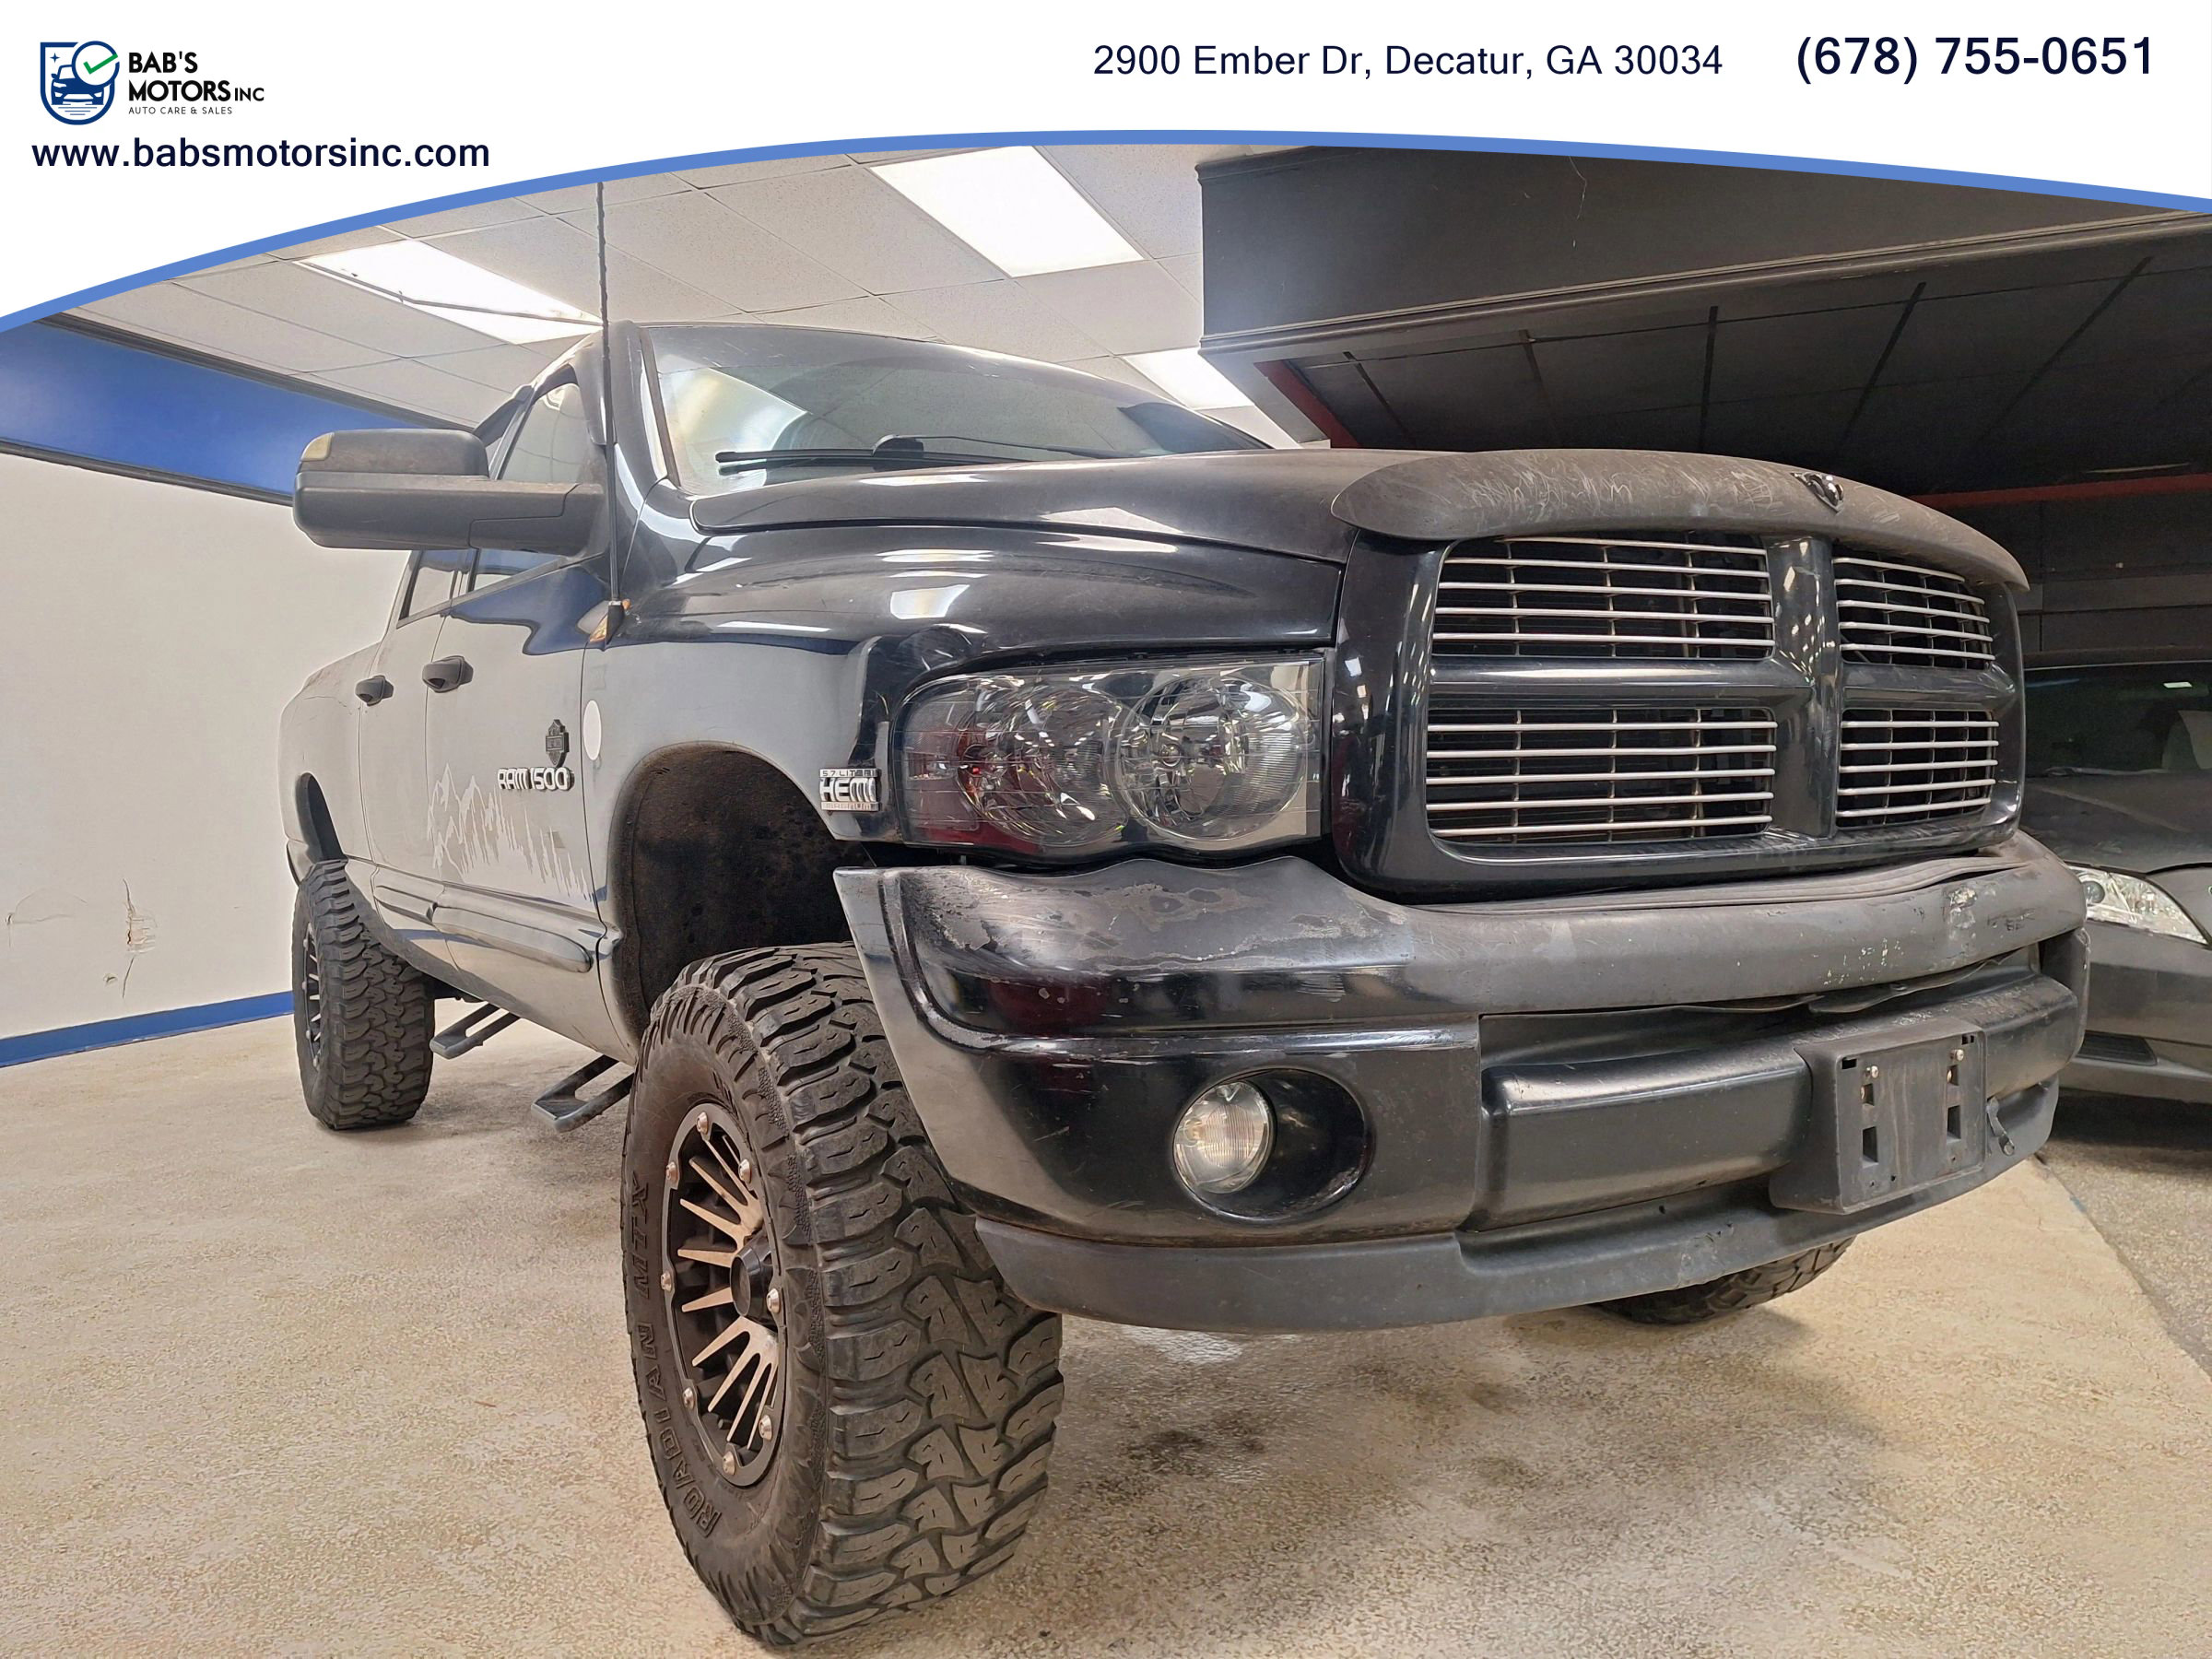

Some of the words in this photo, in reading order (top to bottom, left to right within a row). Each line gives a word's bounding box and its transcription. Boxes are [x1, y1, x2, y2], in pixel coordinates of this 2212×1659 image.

[498, 768, 529, 790] RAM
[529, 767, 571, 792] 1500
[819, 777, 877, 803] HEMI
[631, 1171, 650, 1300] MTX
[638, 1321, 724, 1538] ROADIAN
